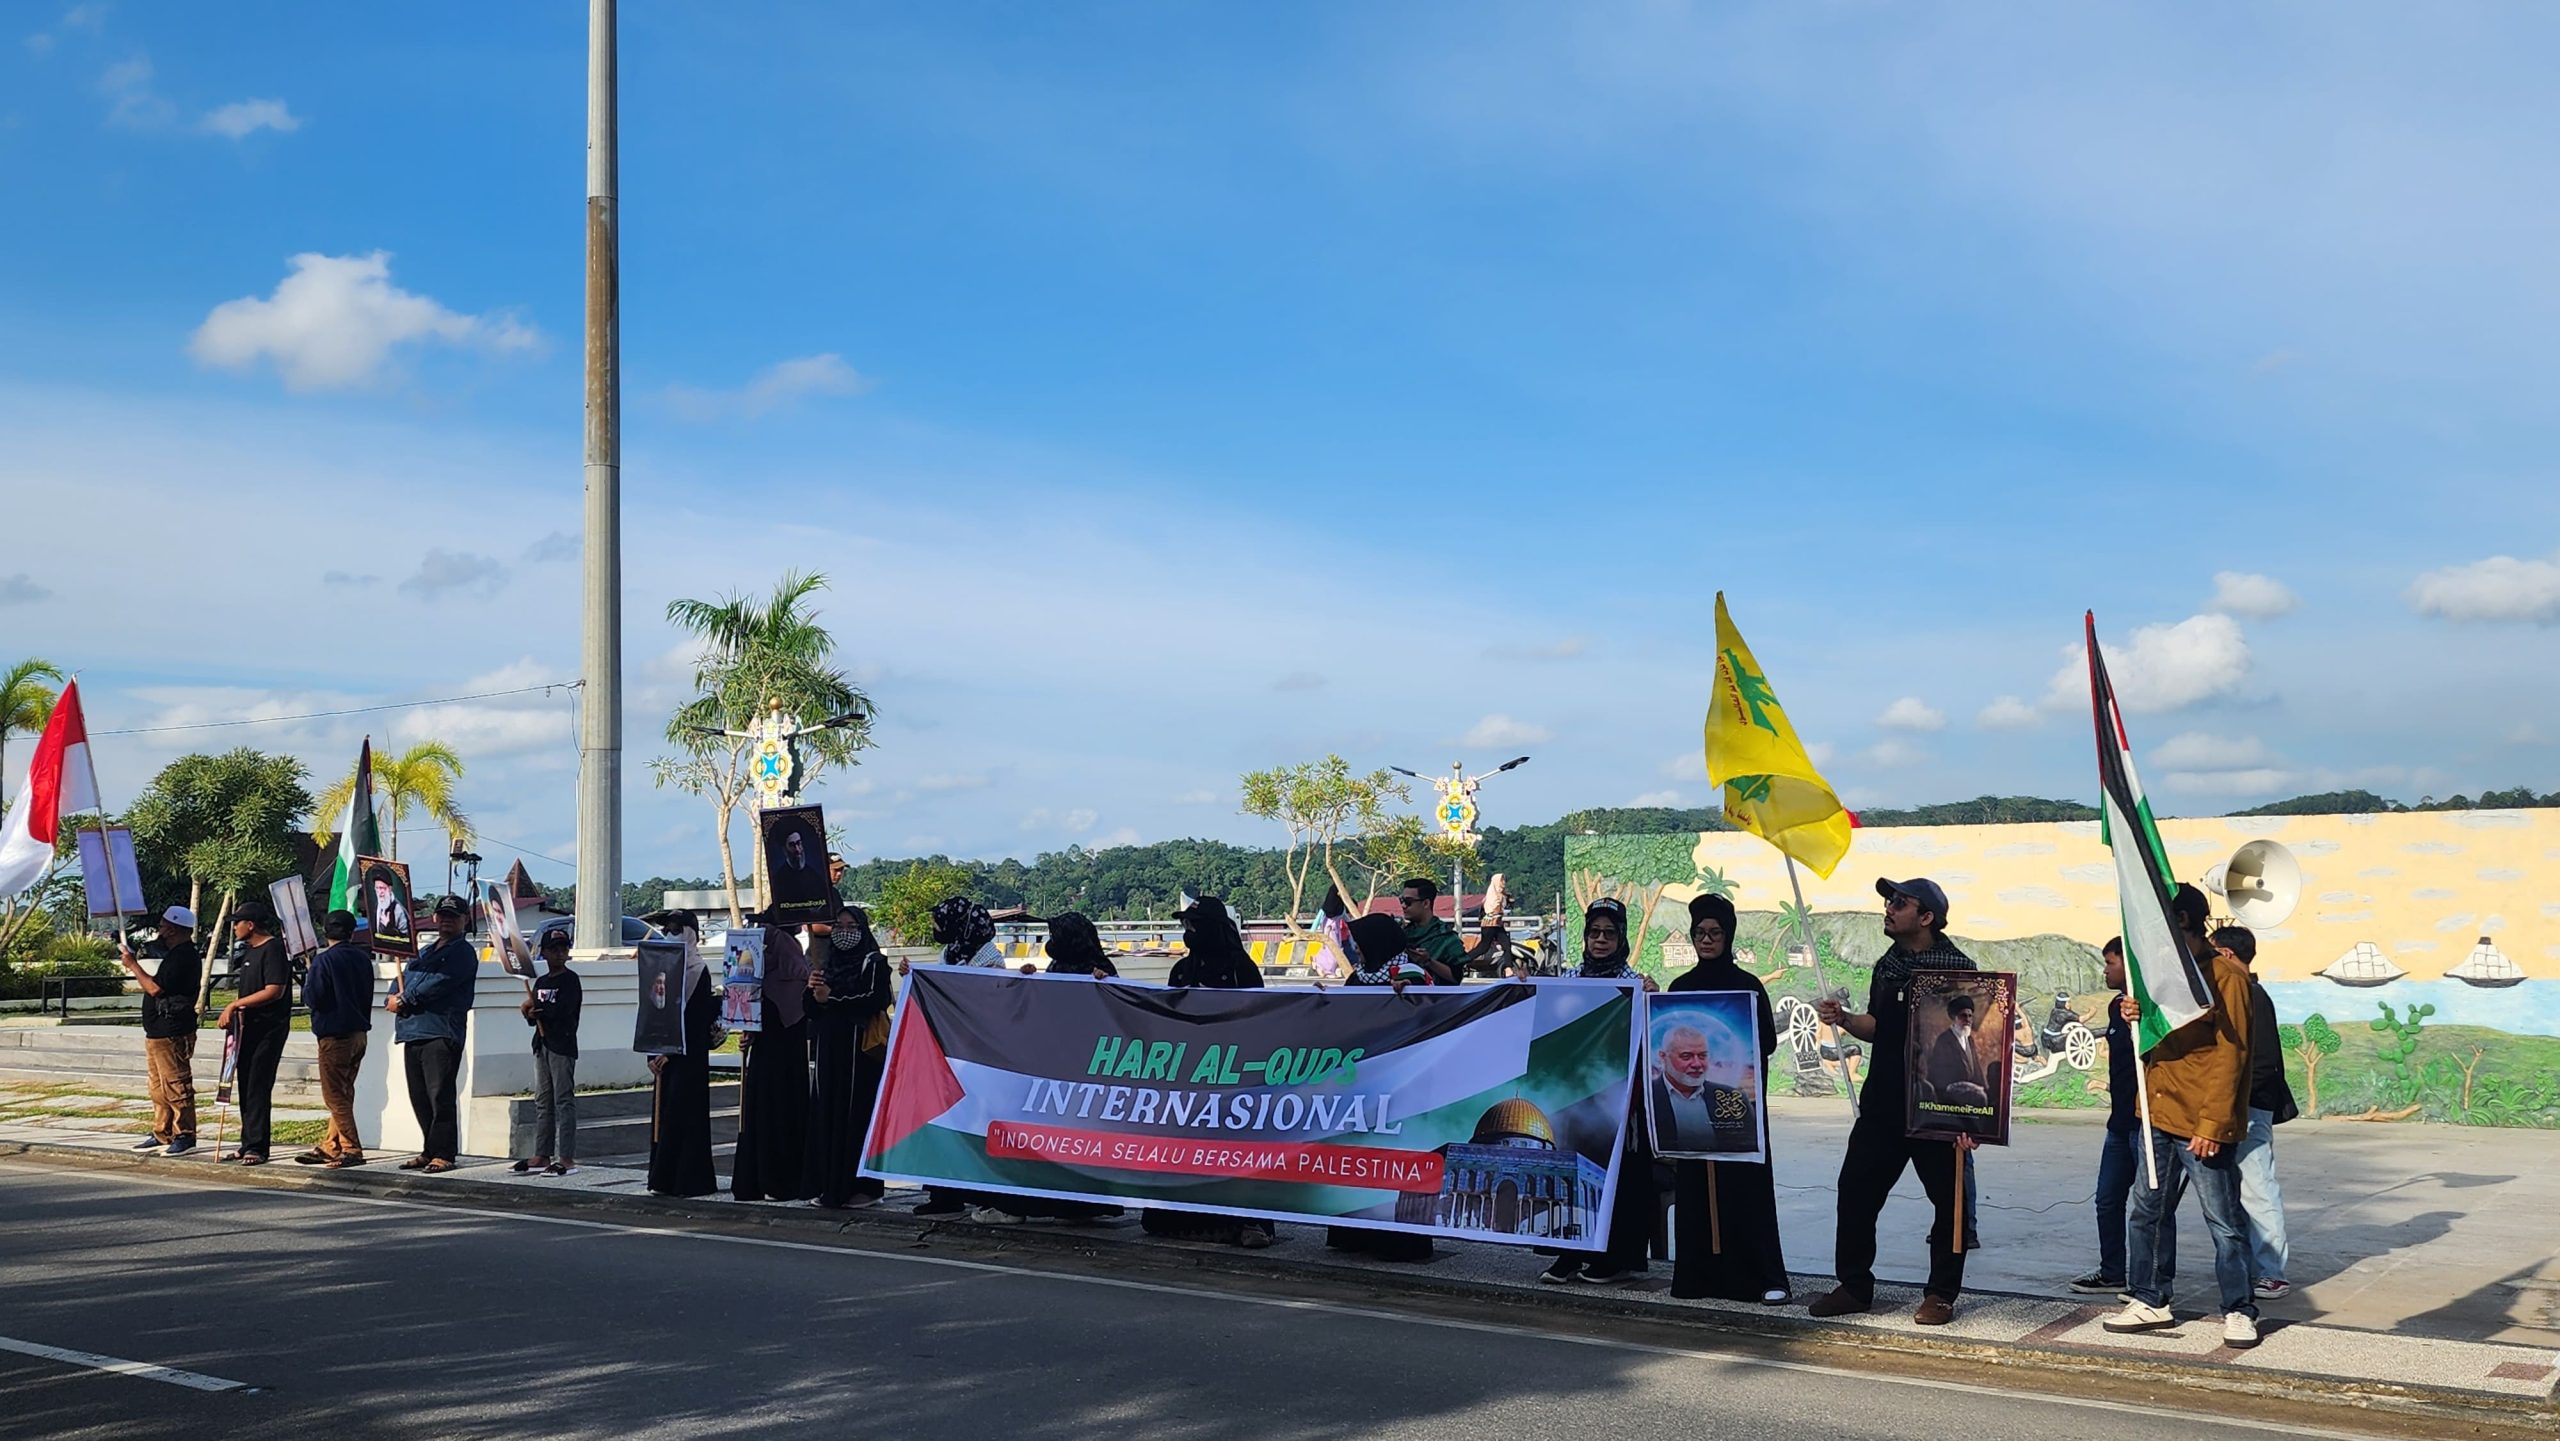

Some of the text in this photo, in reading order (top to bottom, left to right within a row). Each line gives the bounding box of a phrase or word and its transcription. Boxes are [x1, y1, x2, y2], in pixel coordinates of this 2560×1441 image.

[1088, 1037, 1364, 1085] HARI AL-QUDS
[1022, 1078, 1402, 1135] INTERNASIONAL
[1918, 1101, 1994, 1116] #KhameneiForAll
[993, 1128, 1434, 1182] "INDONESIA SELALU BERSAMA PALESTINA"
